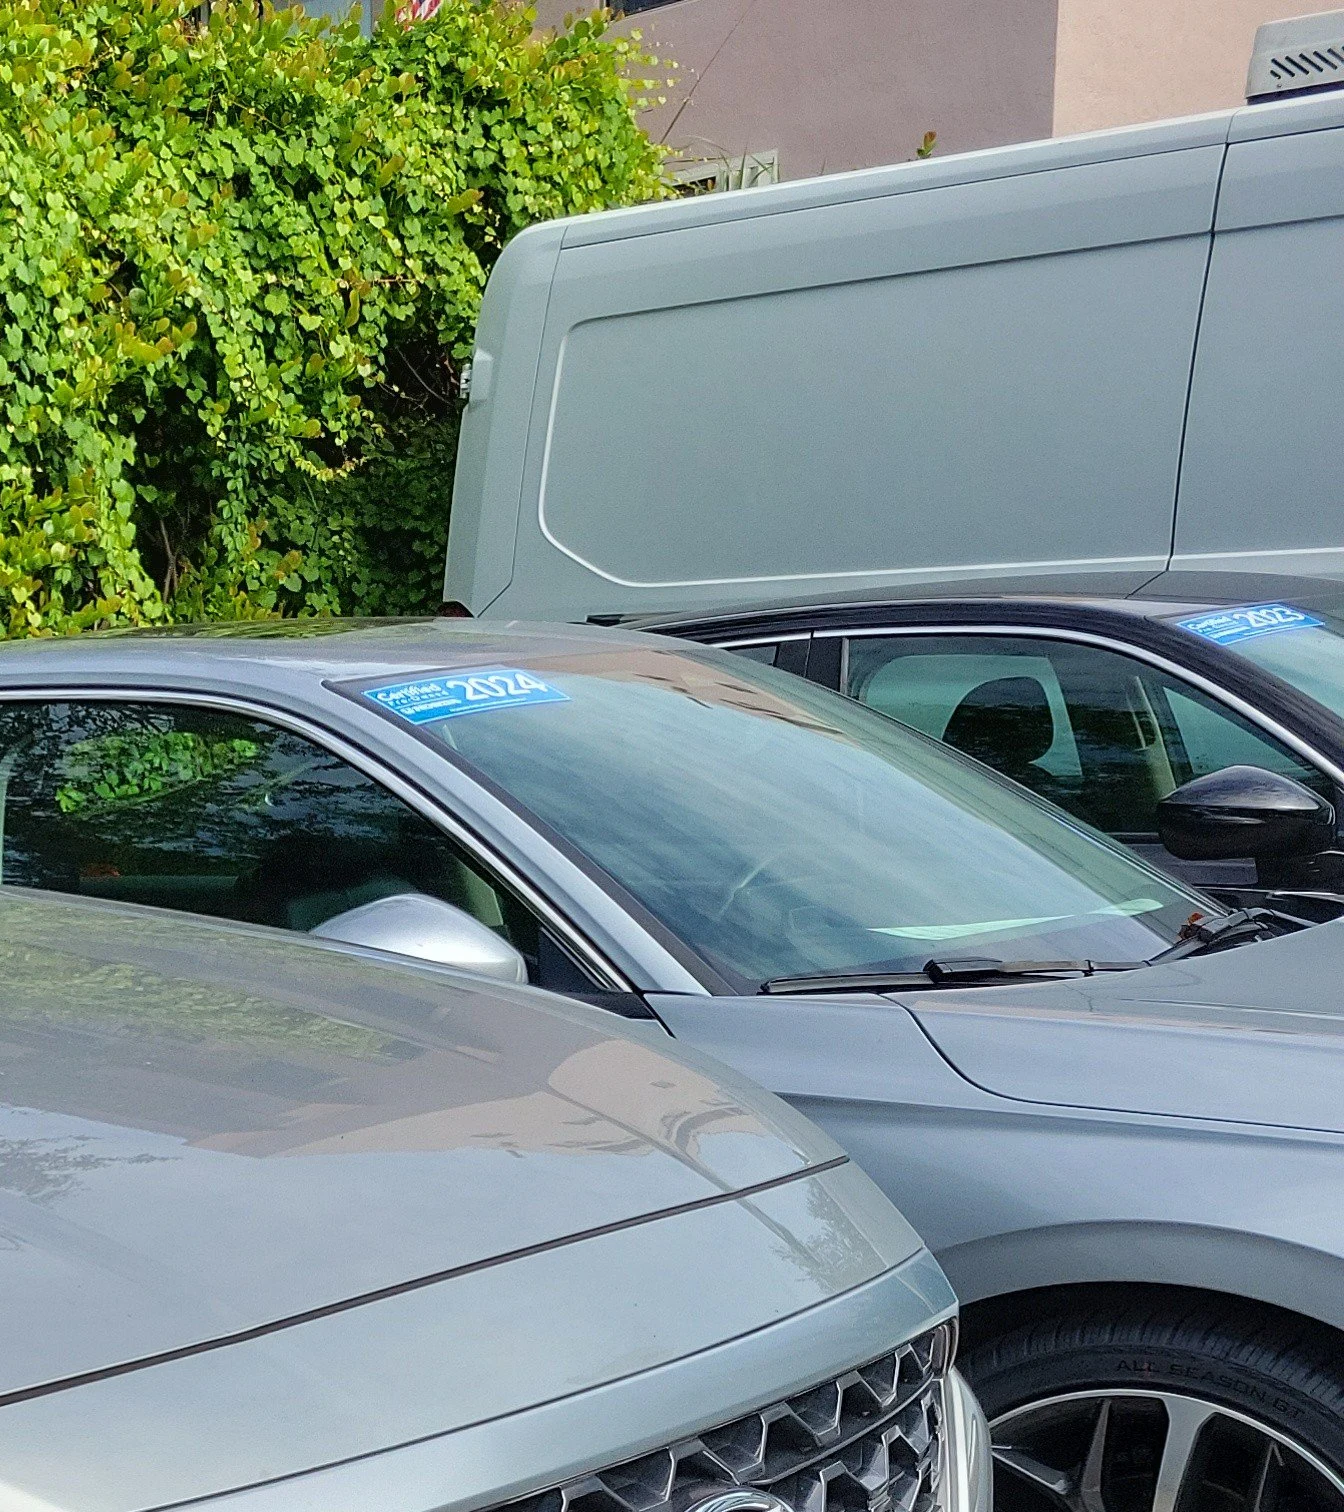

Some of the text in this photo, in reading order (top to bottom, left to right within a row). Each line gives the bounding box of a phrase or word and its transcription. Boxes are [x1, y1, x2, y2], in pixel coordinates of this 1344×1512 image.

[1233, 607, 1305, 628] 2023
[377, 683, 442, 701] Certified
[446, 672, 548, 702] 2024
[1116, 1359, 1160, 1373] ALL
[1168, 1363, 1266, 1400] SEASON
